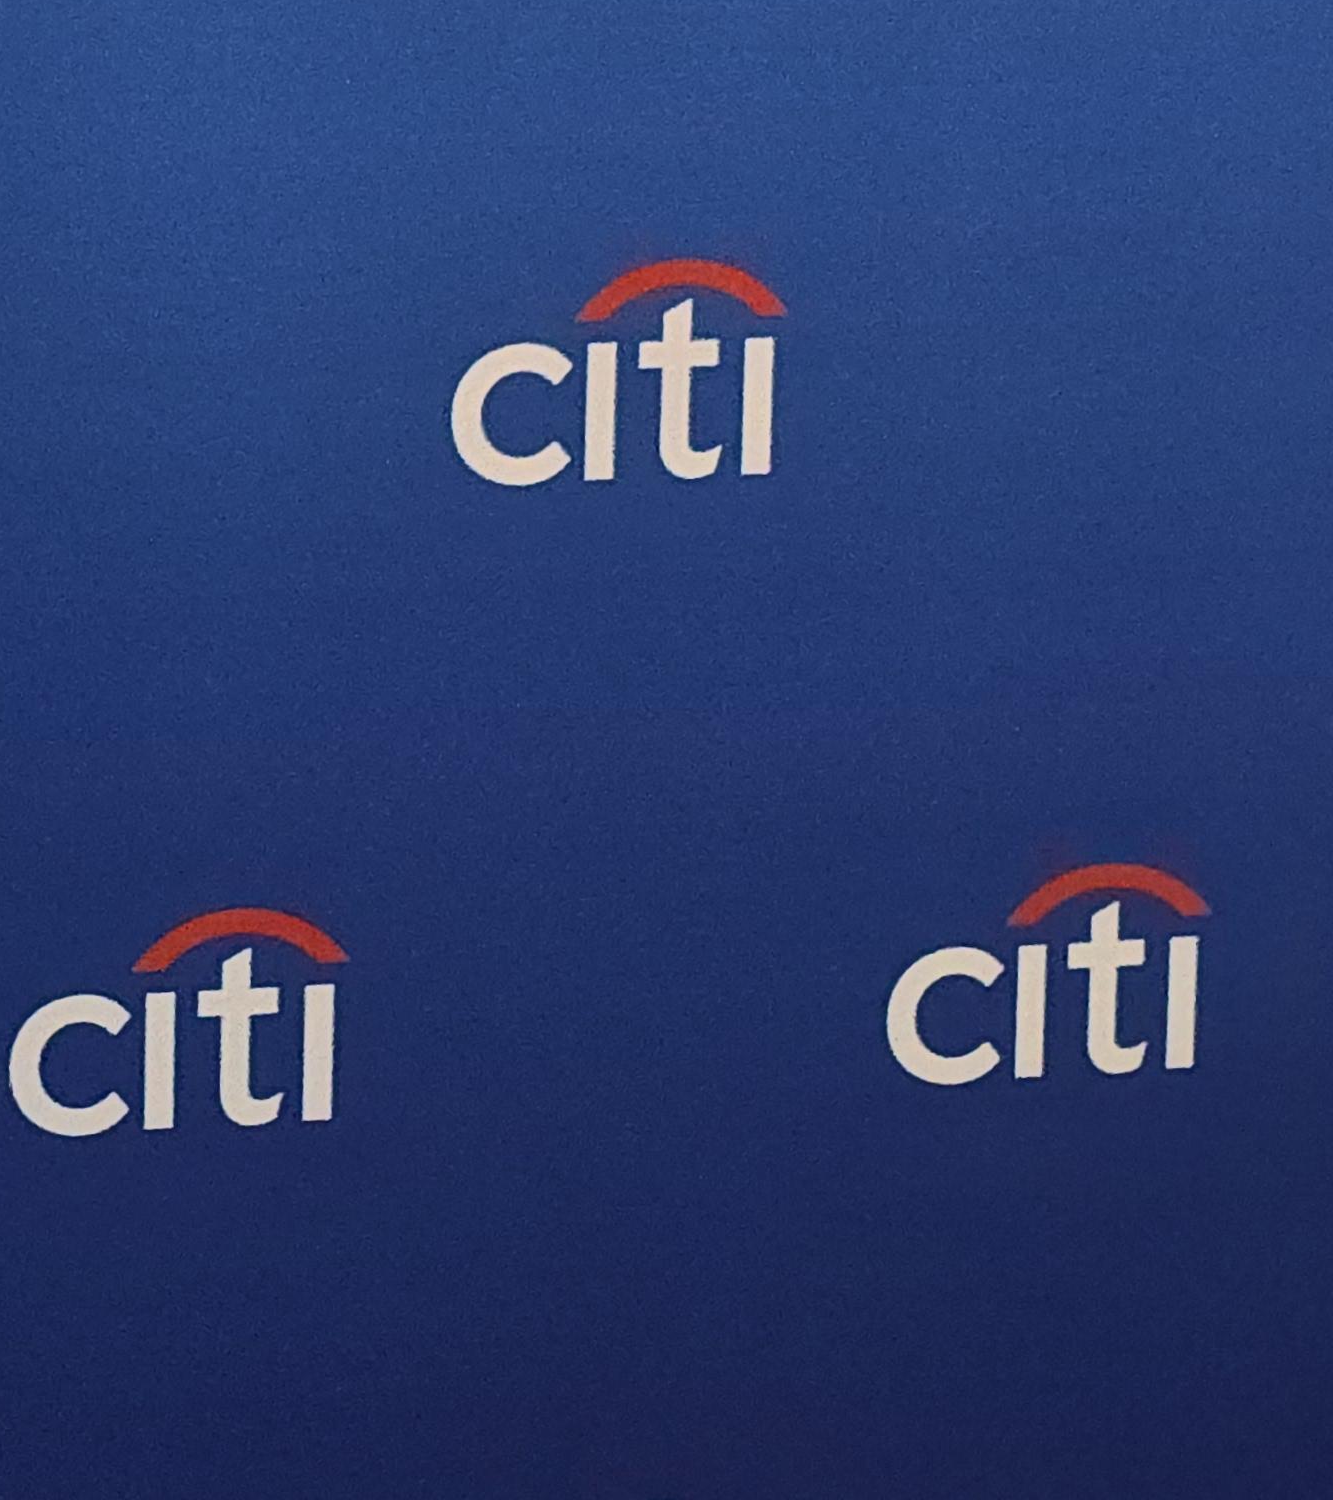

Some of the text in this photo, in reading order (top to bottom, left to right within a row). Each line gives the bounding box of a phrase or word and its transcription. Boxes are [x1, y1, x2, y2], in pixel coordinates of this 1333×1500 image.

[451, 298, 776, 488] citi
[8, 947, 336, 1138] citi
[886, 900, 1201, 1086] citi
